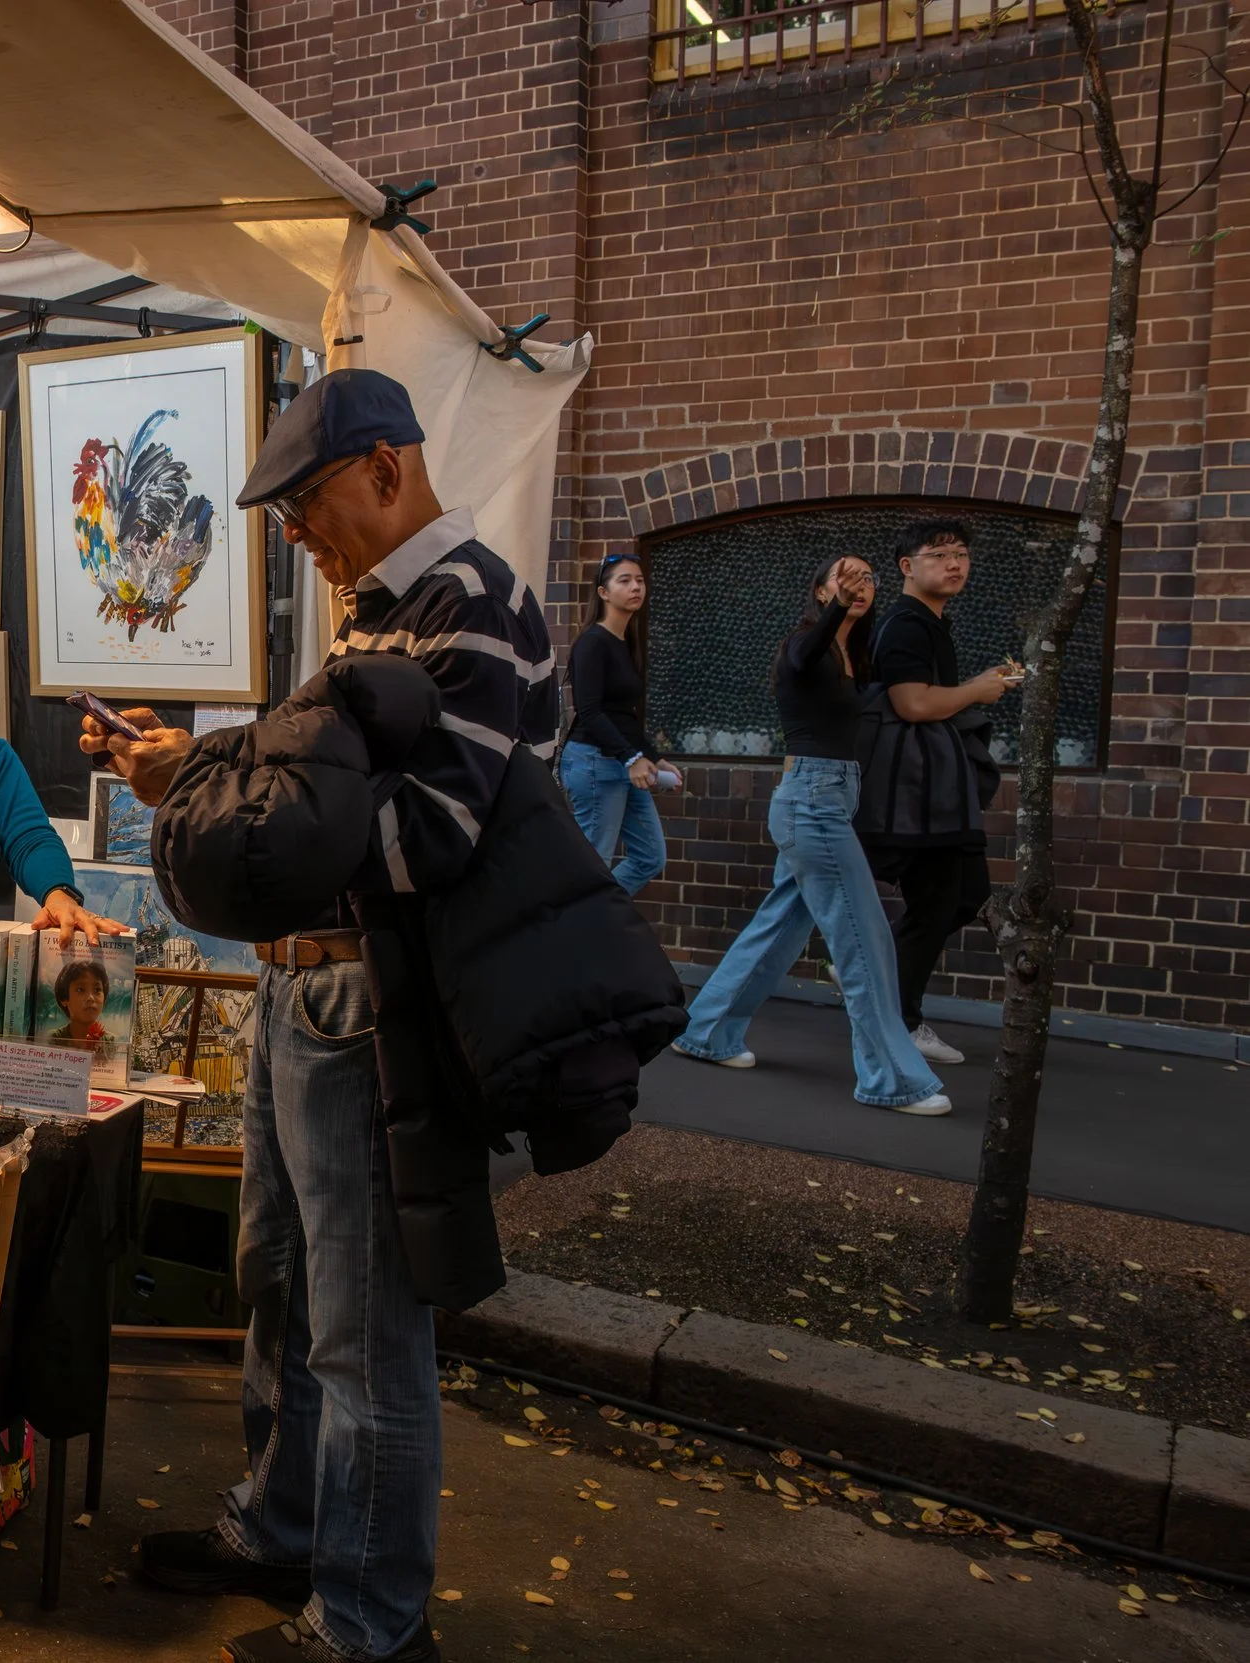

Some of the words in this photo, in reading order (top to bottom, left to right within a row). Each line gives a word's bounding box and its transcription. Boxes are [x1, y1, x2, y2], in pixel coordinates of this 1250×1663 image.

[75, 938, 84, 947] To
[10, 1046, 26, 1056] size
[28, 1048, 46, 1058] Fine
[49, 1051, 62, 1060] Art
[64, 1053, 87, 1064] Paper
